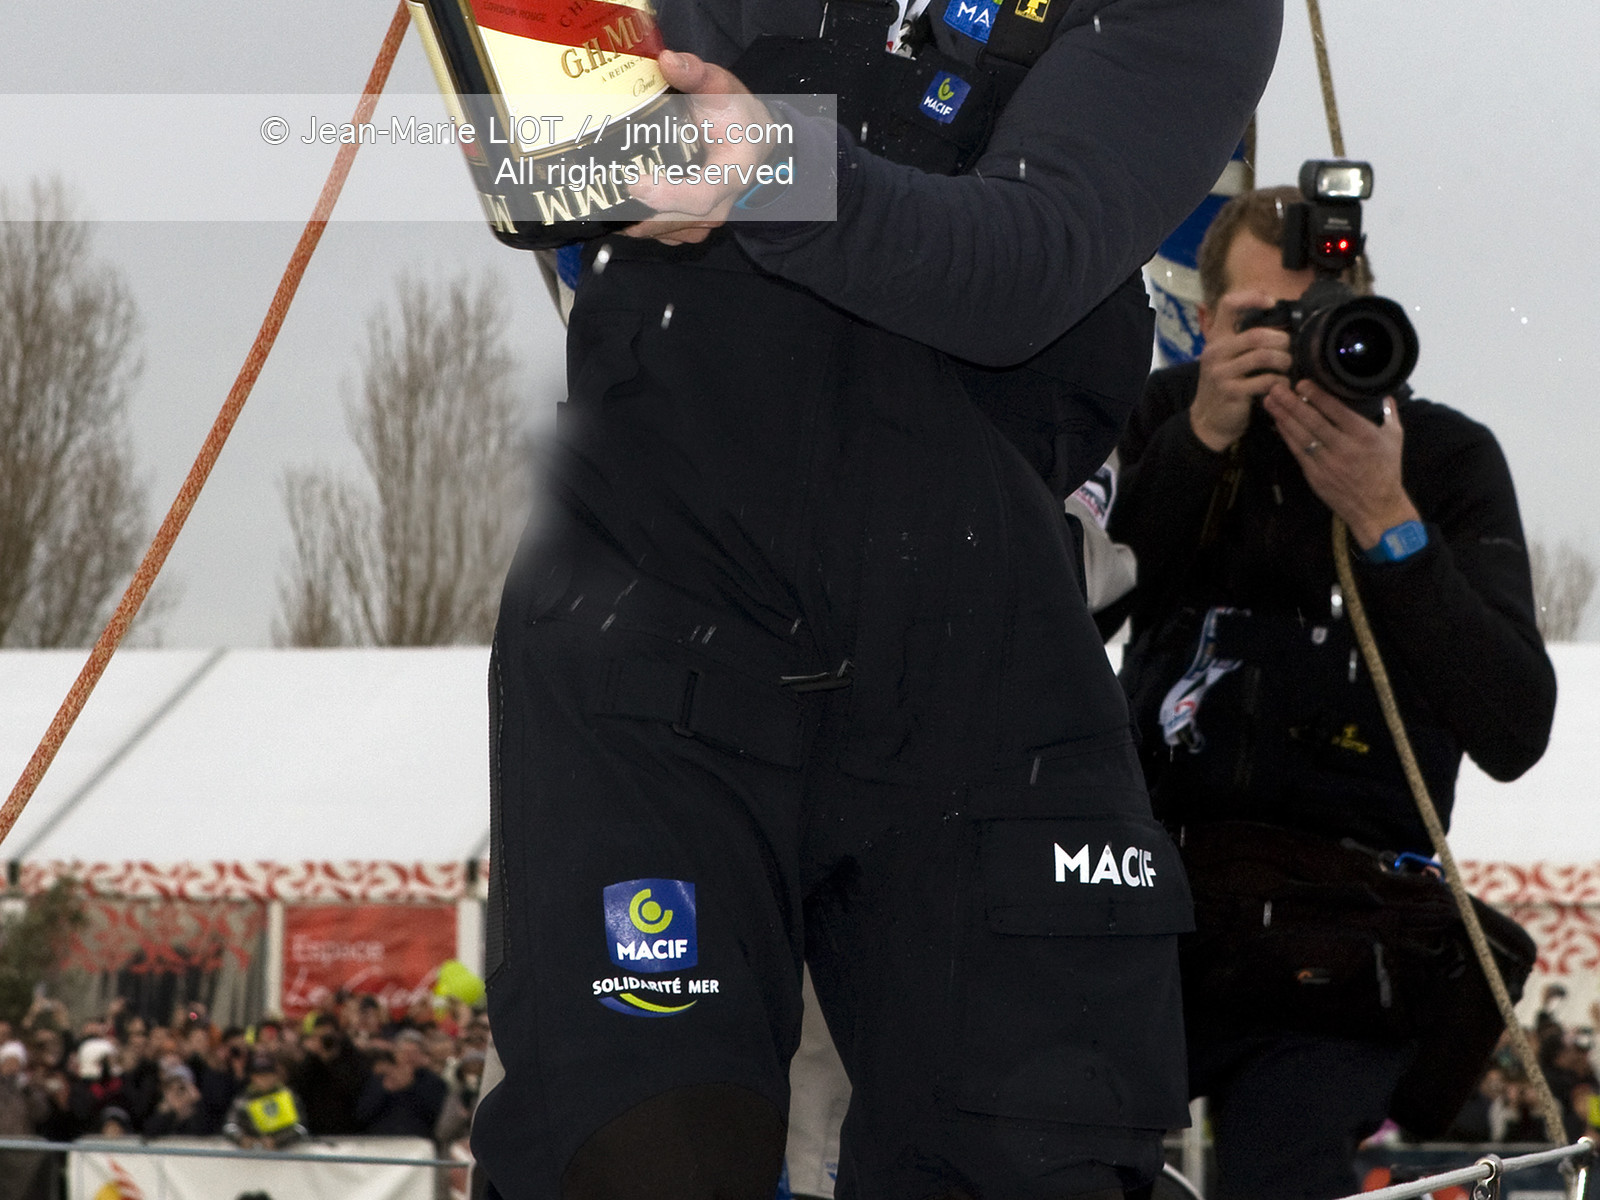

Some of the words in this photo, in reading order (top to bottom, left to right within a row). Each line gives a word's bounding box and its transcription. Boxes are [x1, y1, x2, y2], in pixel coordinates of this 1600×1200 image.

[923, 95, 953, 116] MACIF
[1054, 842, 1157, 888] MACIF
[616, 939, 688, 961] MACIF
[592, 976, 682, 995] SOLIDARITÉ
[688, 980, 719, 994] MER
